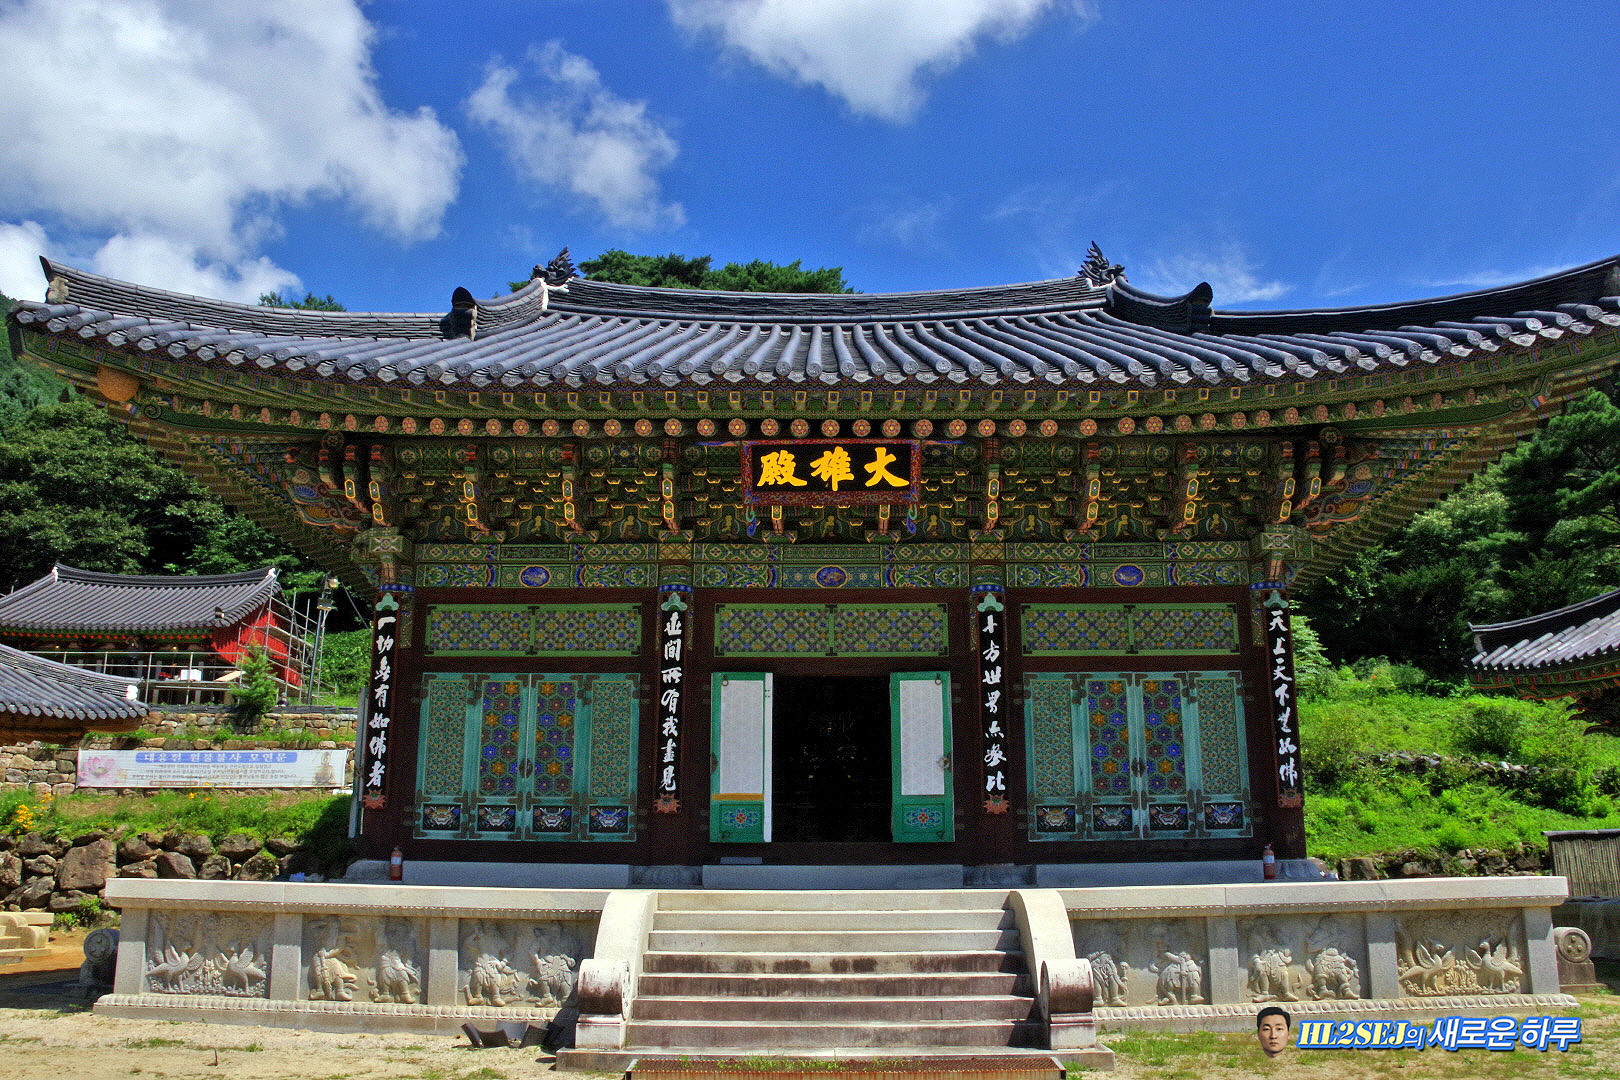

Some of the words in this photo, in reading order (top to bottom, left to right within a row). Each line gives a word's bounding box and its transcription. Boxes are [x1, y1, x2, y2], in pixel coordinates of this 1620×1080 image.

[756, 446, 910, 492] 大雄殿
[144, 752, 182, 762] 대웅전
